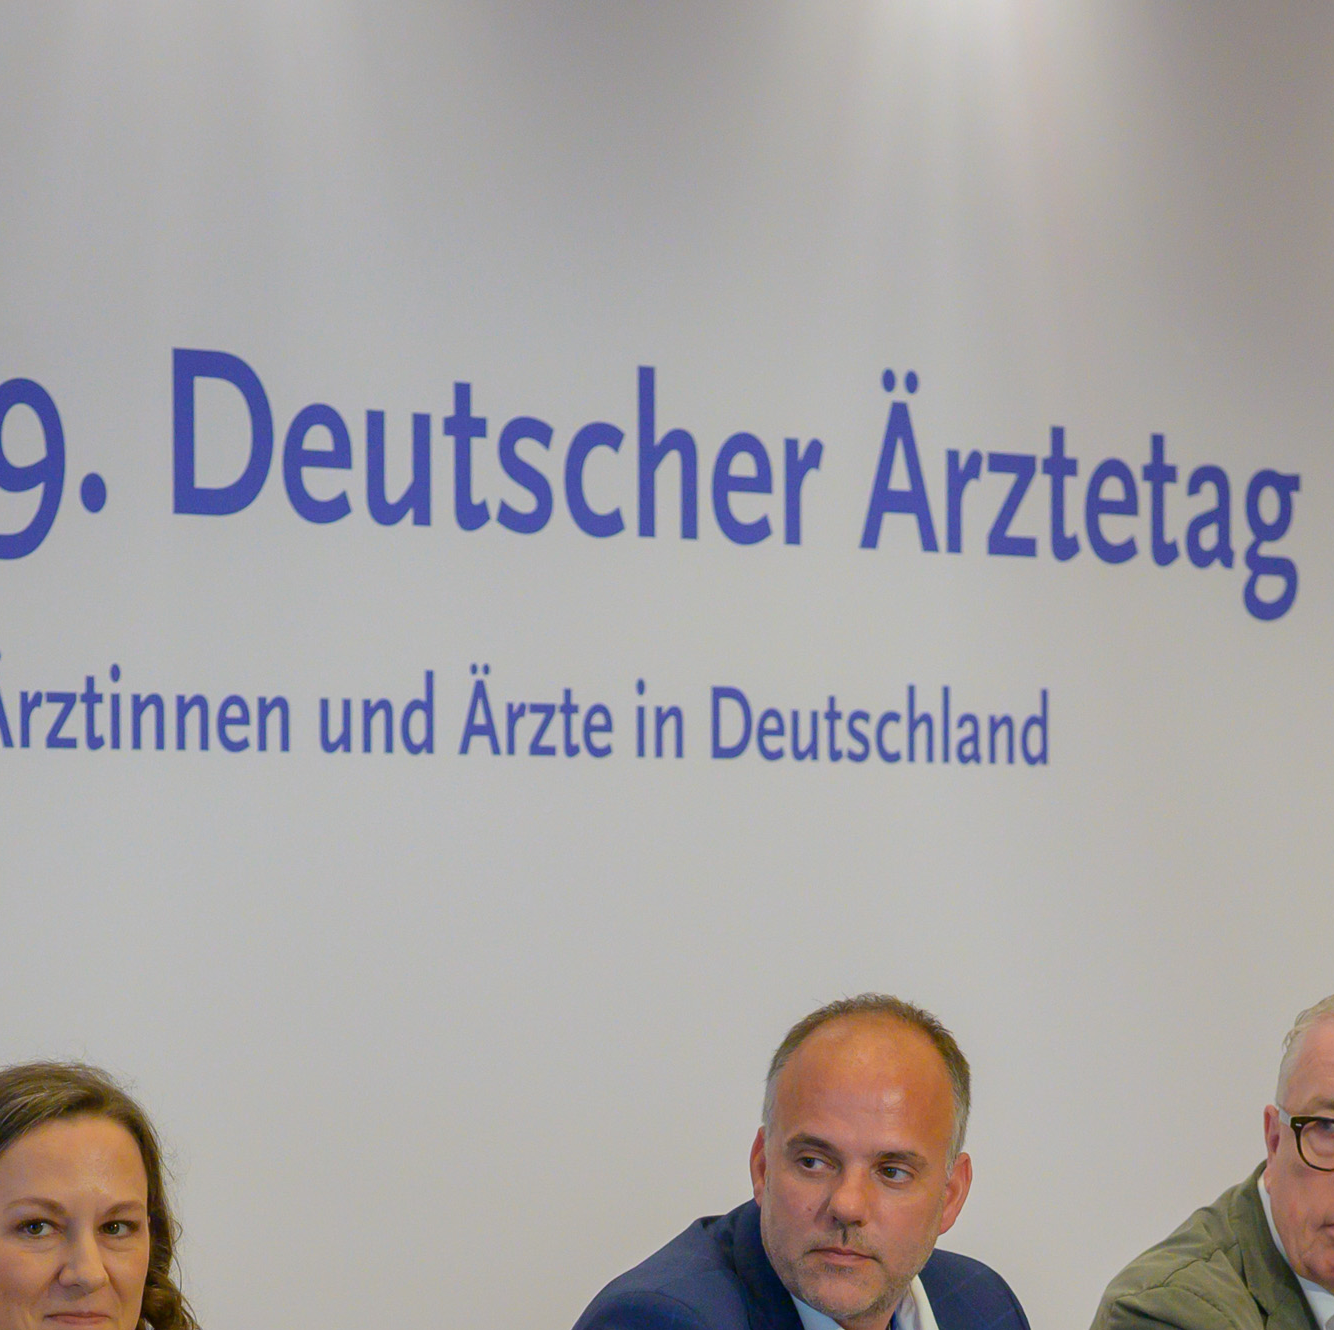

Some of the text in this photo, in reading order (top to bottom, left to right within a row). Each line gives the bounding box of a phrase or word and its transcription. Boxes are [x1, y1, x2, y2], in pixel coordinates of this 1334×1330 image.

[172, 347, 825, 547] Deutscher
[859, 368, 1301, 622] Ärztetag
[318, 669, 435, 756] und
[457, 663, 614, 759] Ärzte
[635, 678, 685, 759] in
[710, 685, 1051, 767] Deutschland
